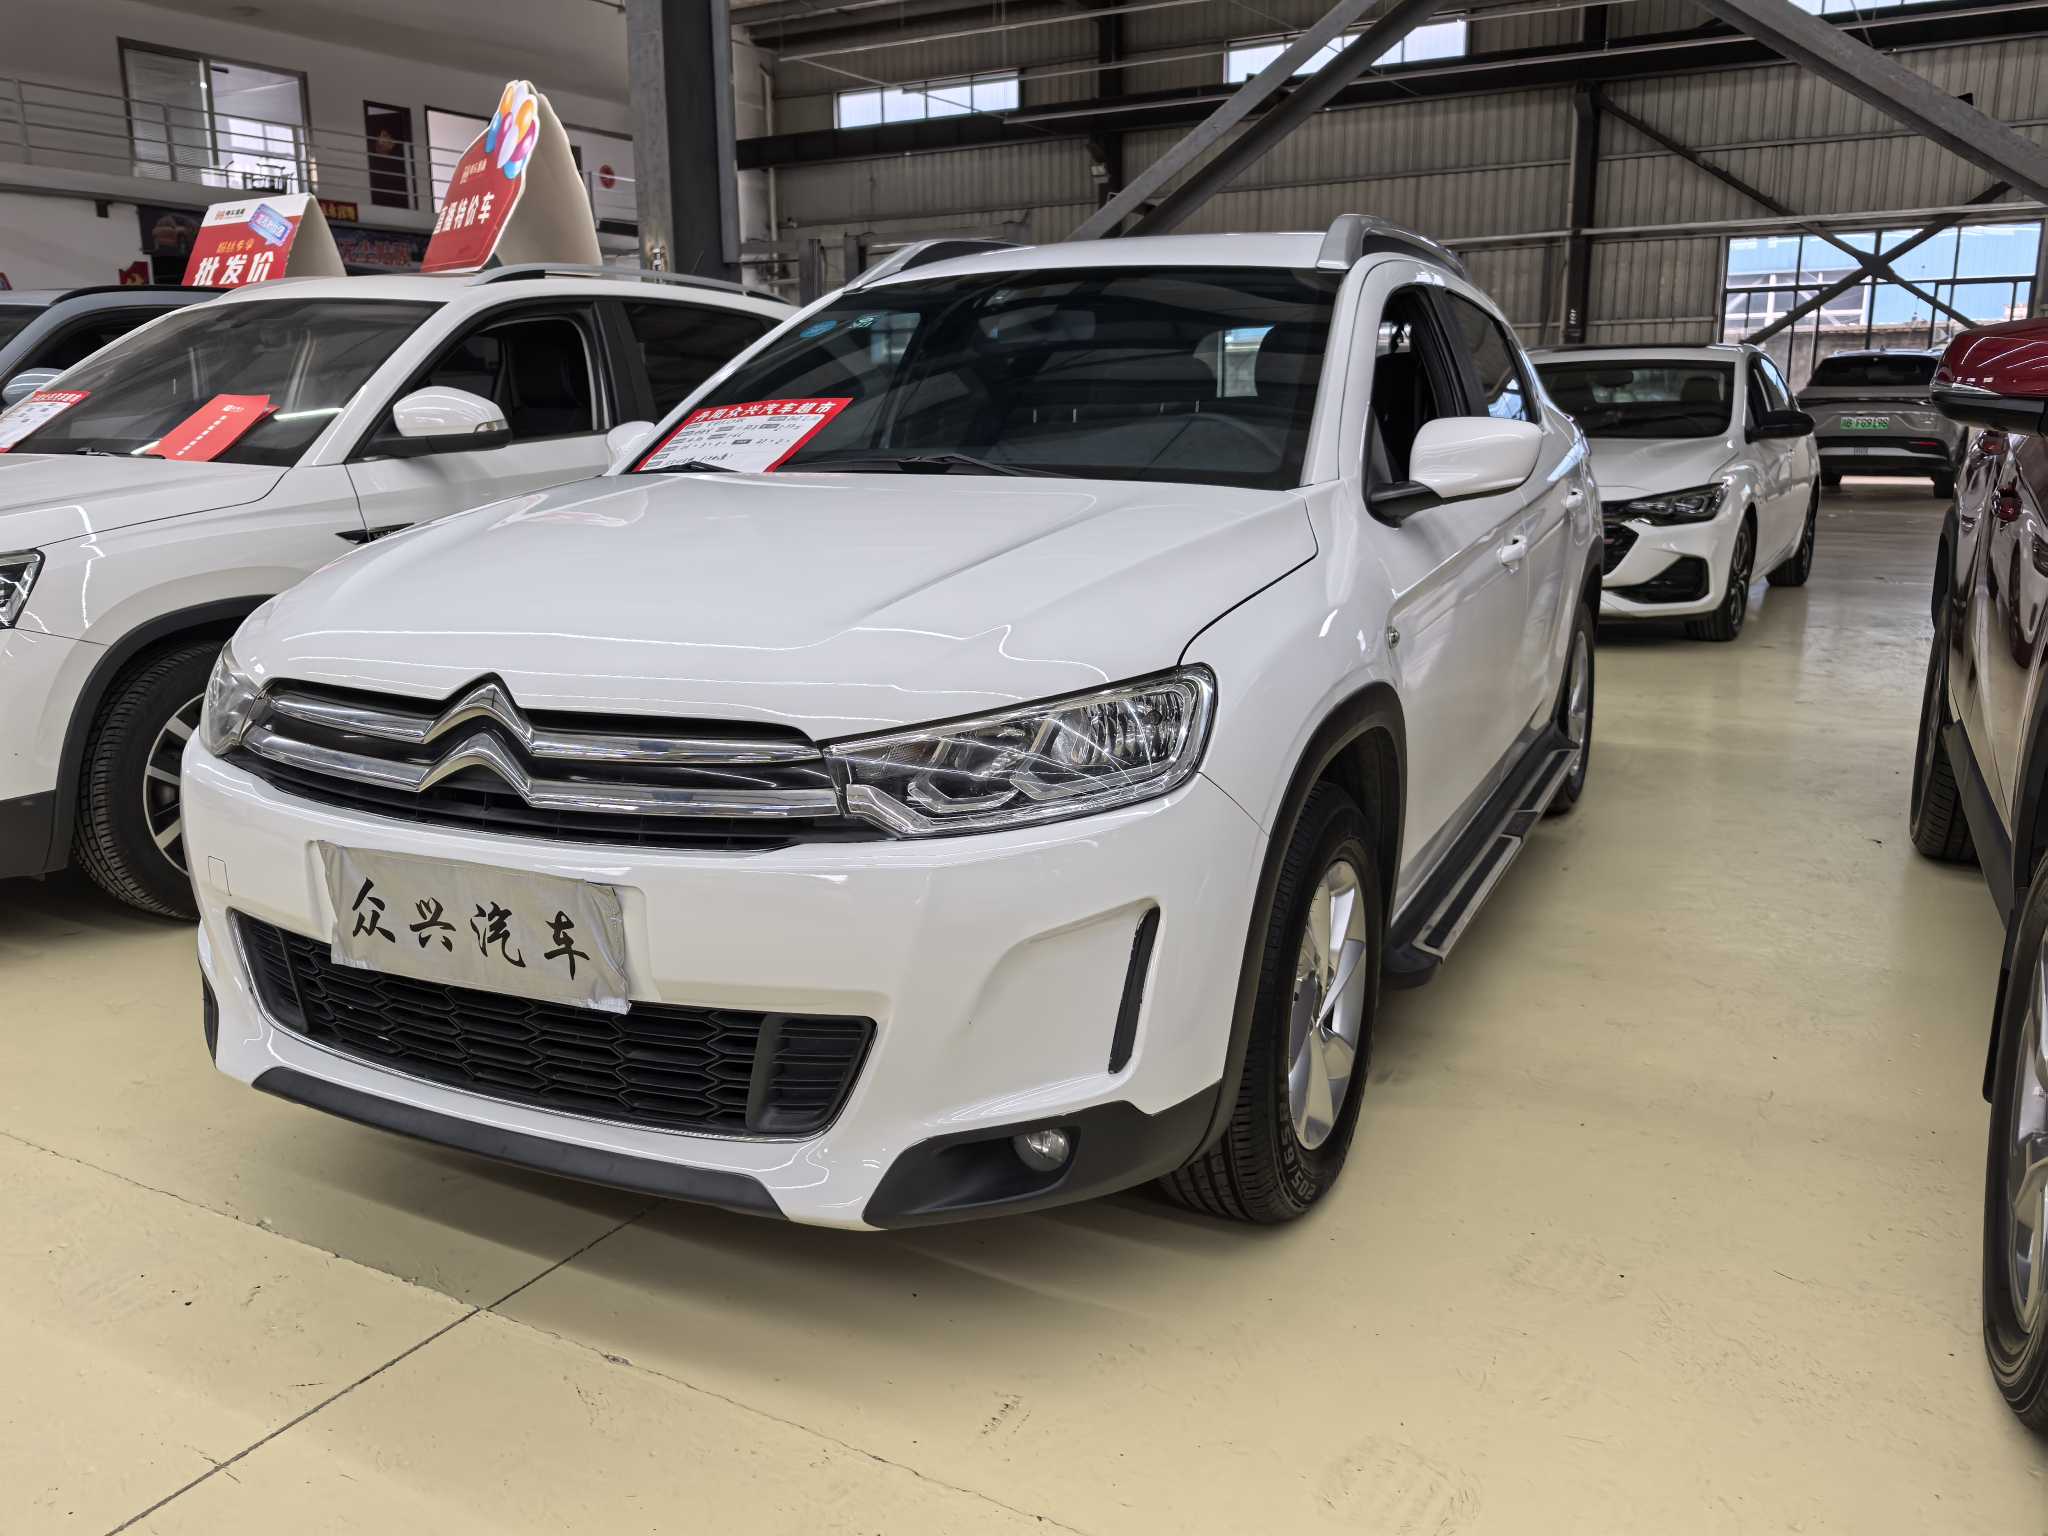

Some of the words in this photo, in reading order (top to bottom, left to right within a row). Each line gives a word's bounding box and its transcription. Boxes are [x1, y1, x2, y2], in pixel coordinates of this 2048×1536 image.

[193, 251, 274, 286] 批发价
[352, 877, 590, 981] 众兴汽车
